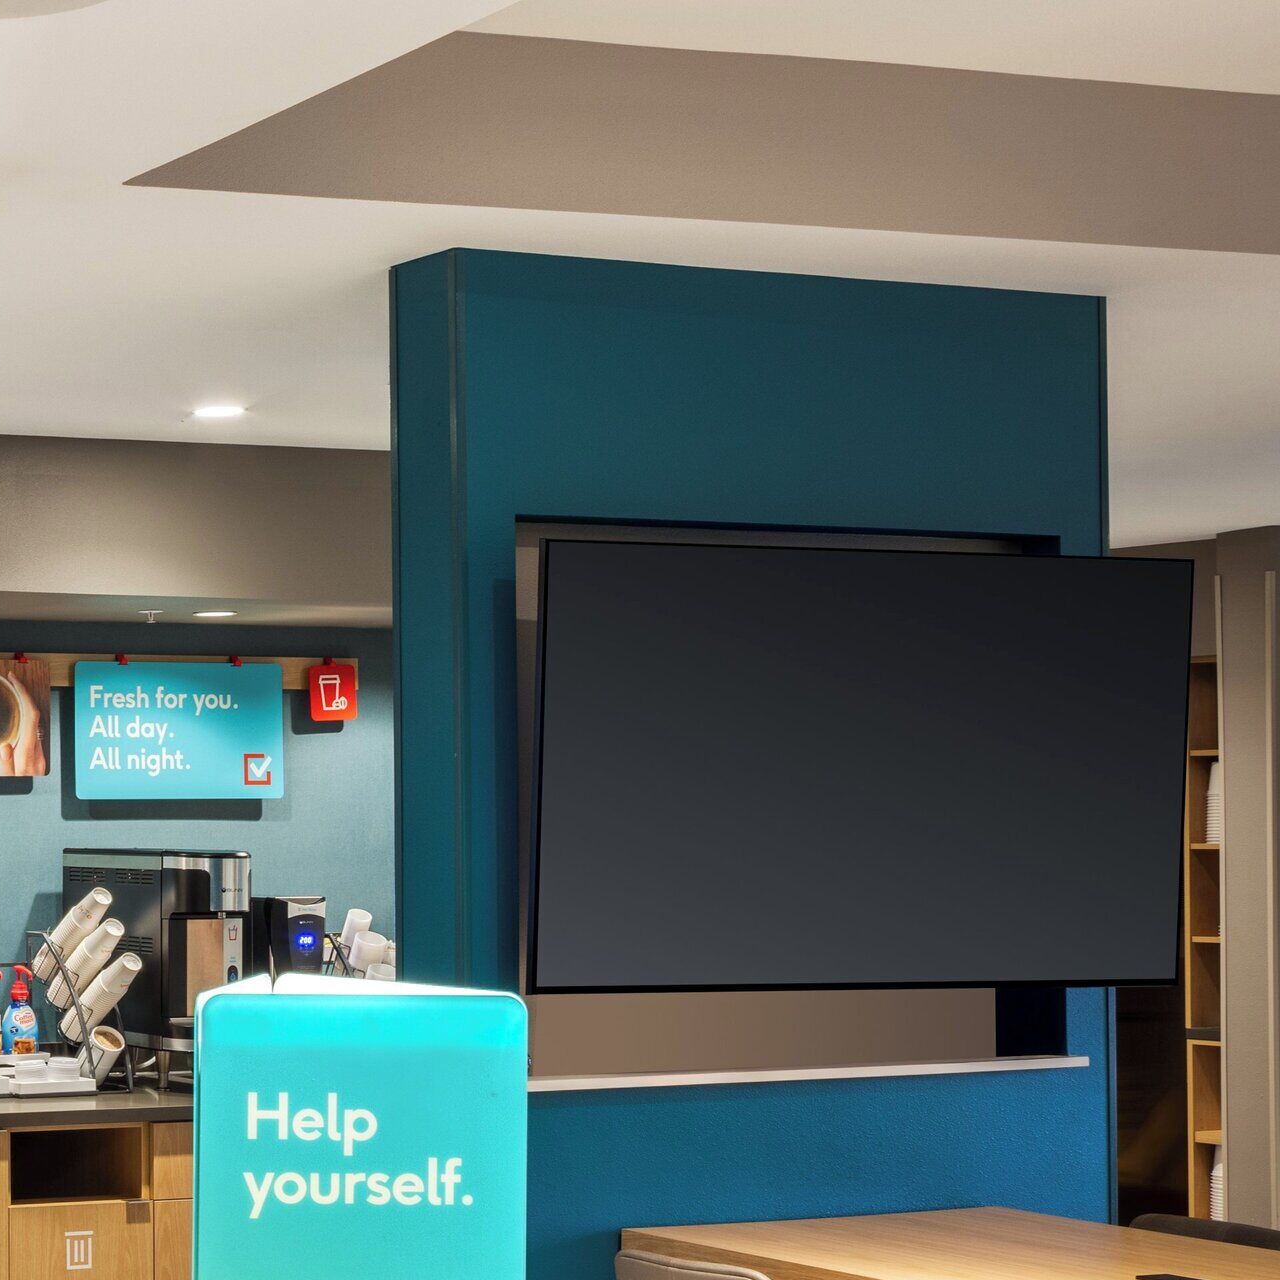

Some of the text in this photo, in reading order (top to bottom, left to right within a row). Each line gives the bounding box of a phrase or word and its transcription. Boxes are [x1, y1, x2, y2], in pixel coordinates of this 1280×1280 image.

[90, 685, 239, 717] Fresh for you.
[89, 715, 174, 745] All day.
[89, 746, 191, 777] All night.
[246, 1091, 378, 1157] Help
[242, 1157, 474, 1219] yourself.
